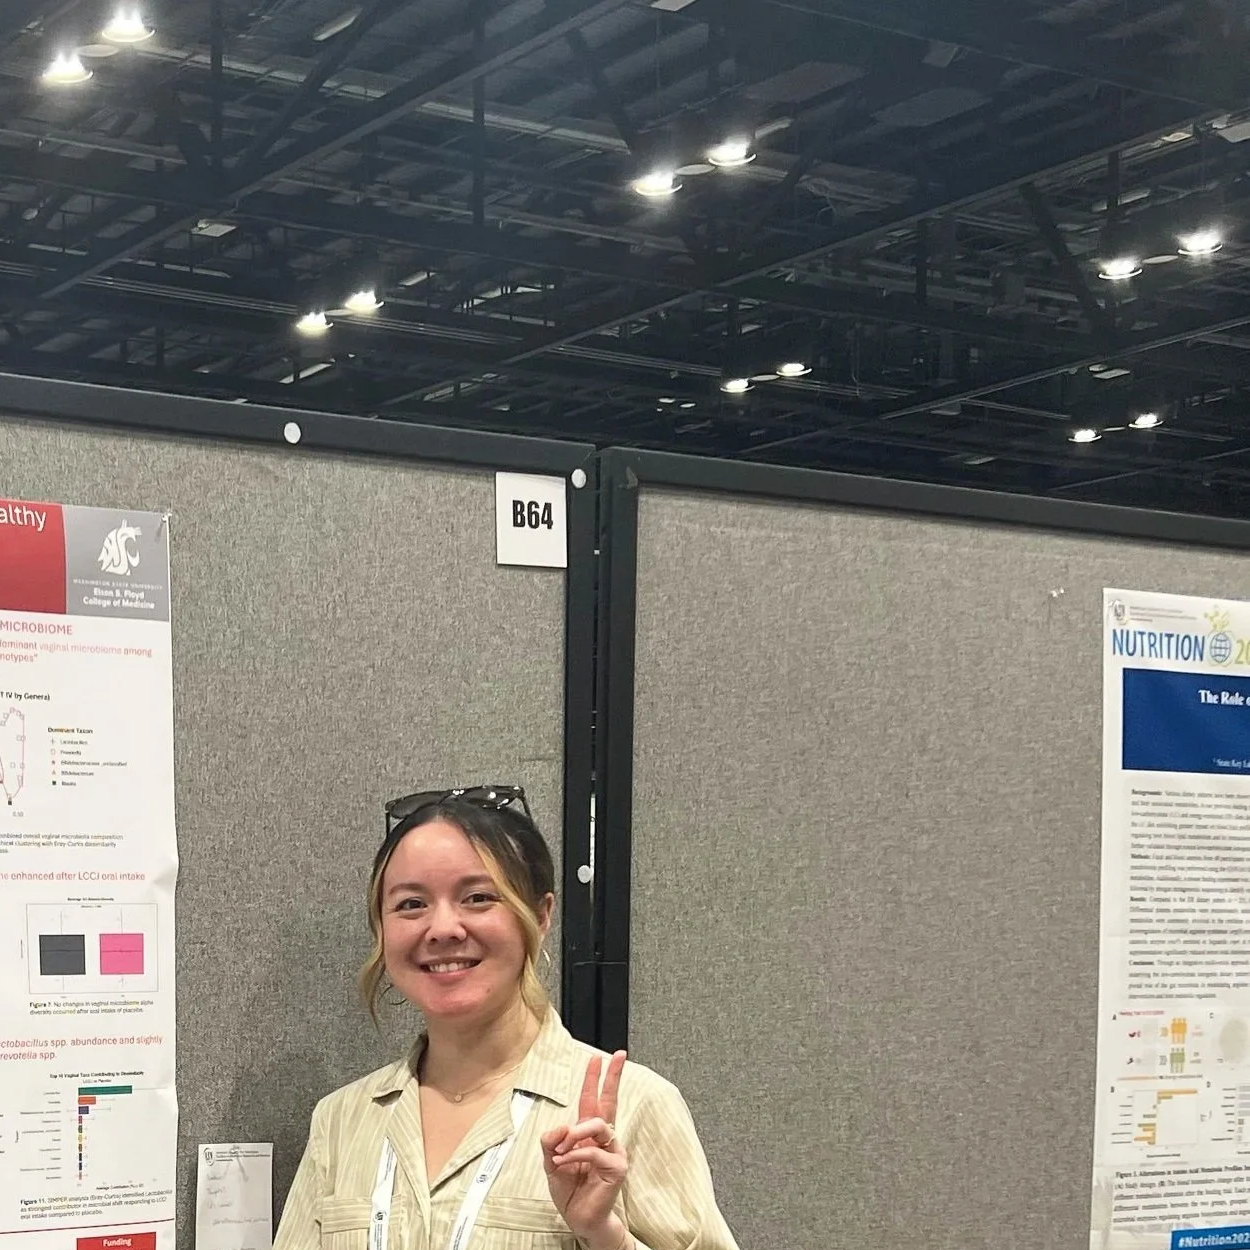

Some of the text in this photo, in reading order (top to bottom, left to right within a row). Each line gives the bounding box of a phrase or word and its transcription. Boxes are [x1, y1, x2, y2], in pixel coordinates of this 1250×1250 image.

[511, 498, 554, 530] B64
[1112, 628, 1205, 662] NUTRITION
[1198, 690, 1244, 706] The Role
[102, 1237, 132, 1247] Funding
